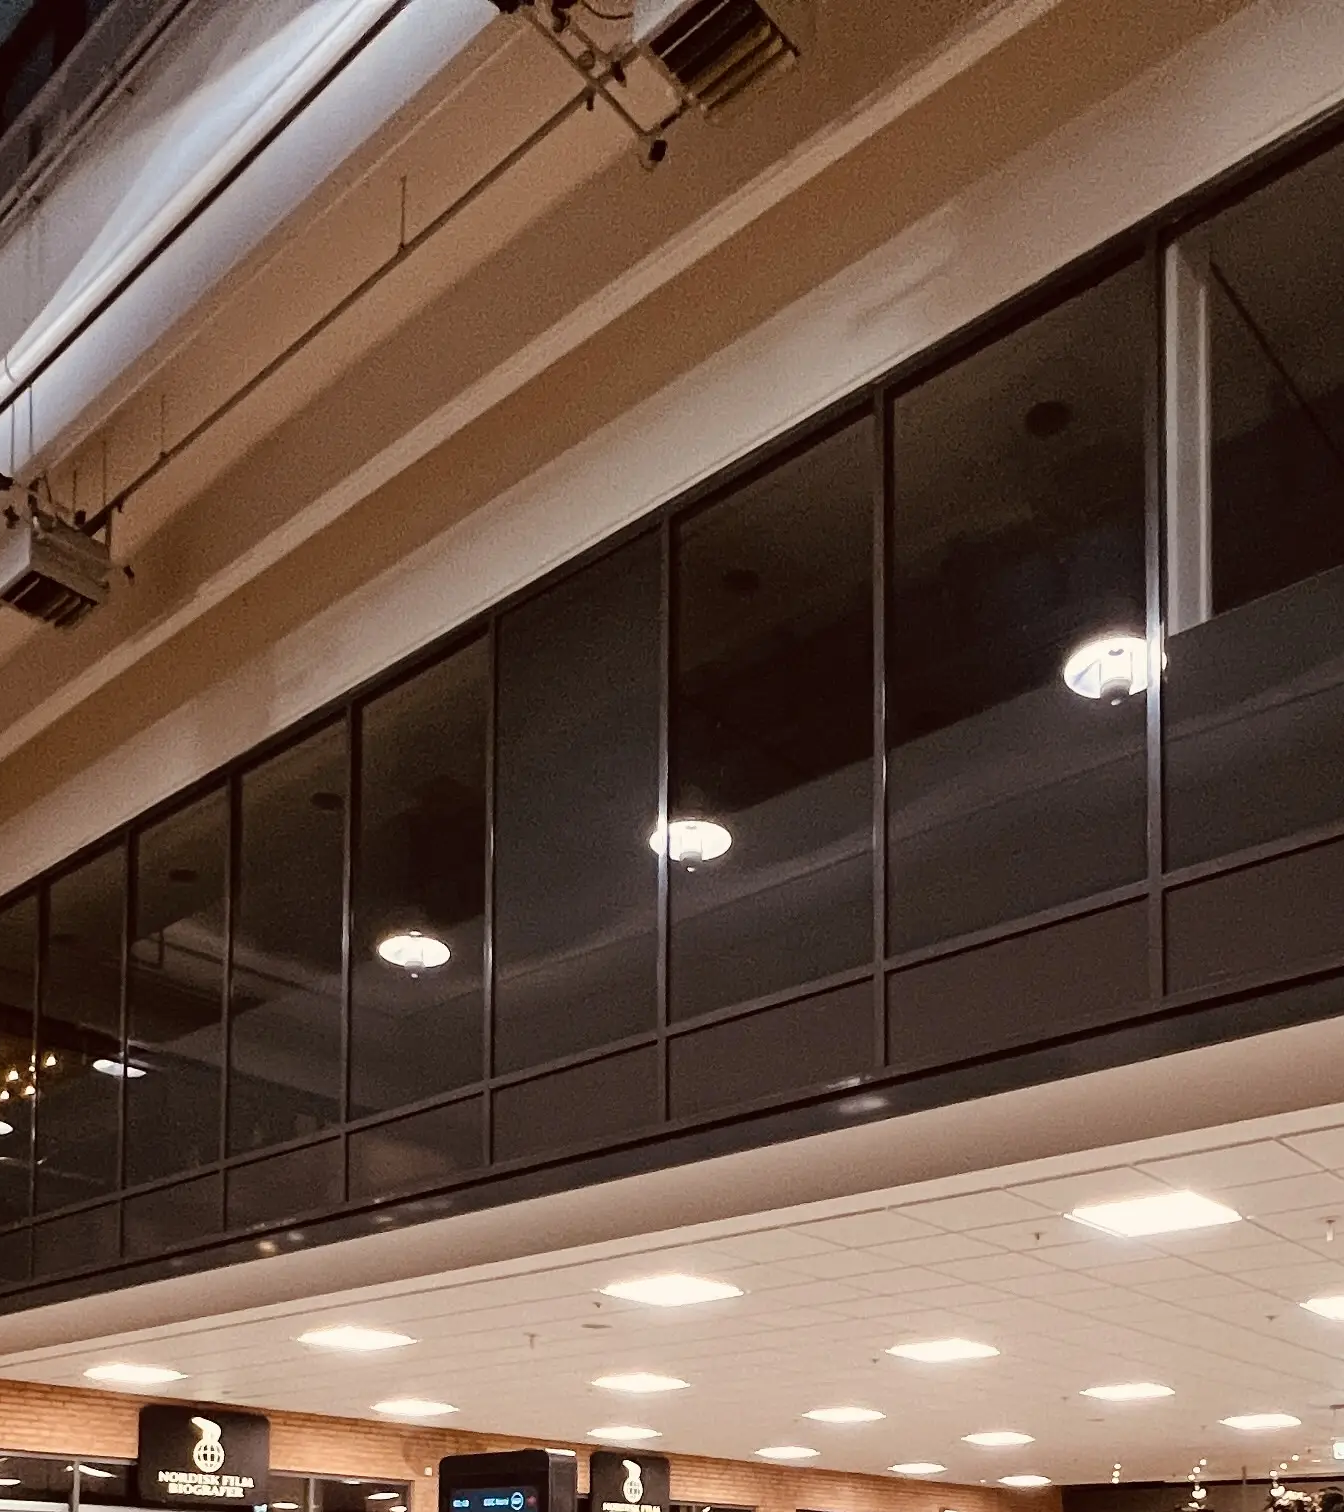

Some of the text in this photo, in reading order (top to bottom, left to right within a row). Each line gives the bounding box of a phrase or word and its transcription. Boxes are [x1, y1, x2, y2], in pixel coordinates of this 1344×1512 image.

[158, 1470, 255, 1489] NORDISK FILM
[168, 1482, 245, 1498] BIOGRAFER
